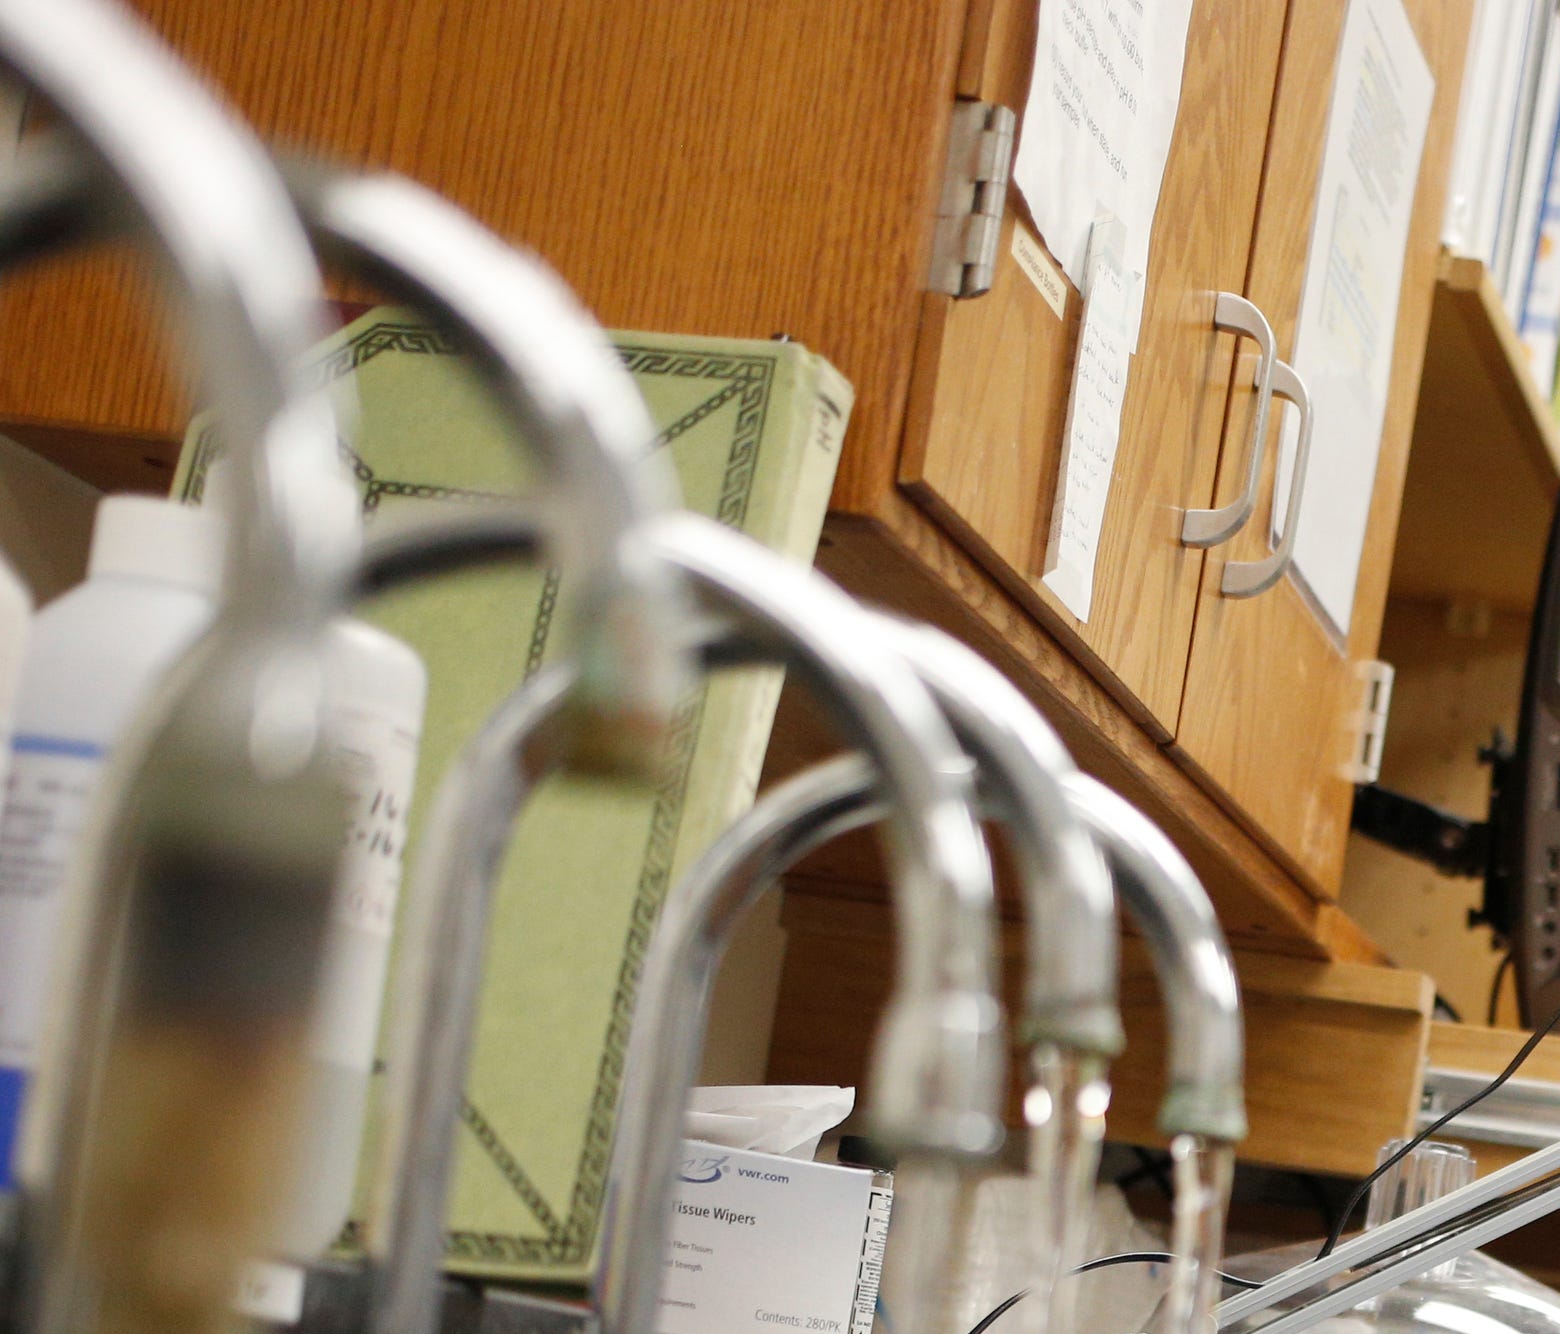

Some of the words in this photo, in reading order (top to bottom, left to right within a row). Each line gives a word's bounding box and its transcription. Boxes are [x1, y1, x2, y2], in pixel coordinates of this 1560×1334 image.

[737, 1167, 790, 1185] vwr.com
[713, 1207, 757, 1226] Wipers
[754, 1307, 803, 1328] Contents:
[805, 1315, 842, 1333] 280/PK
